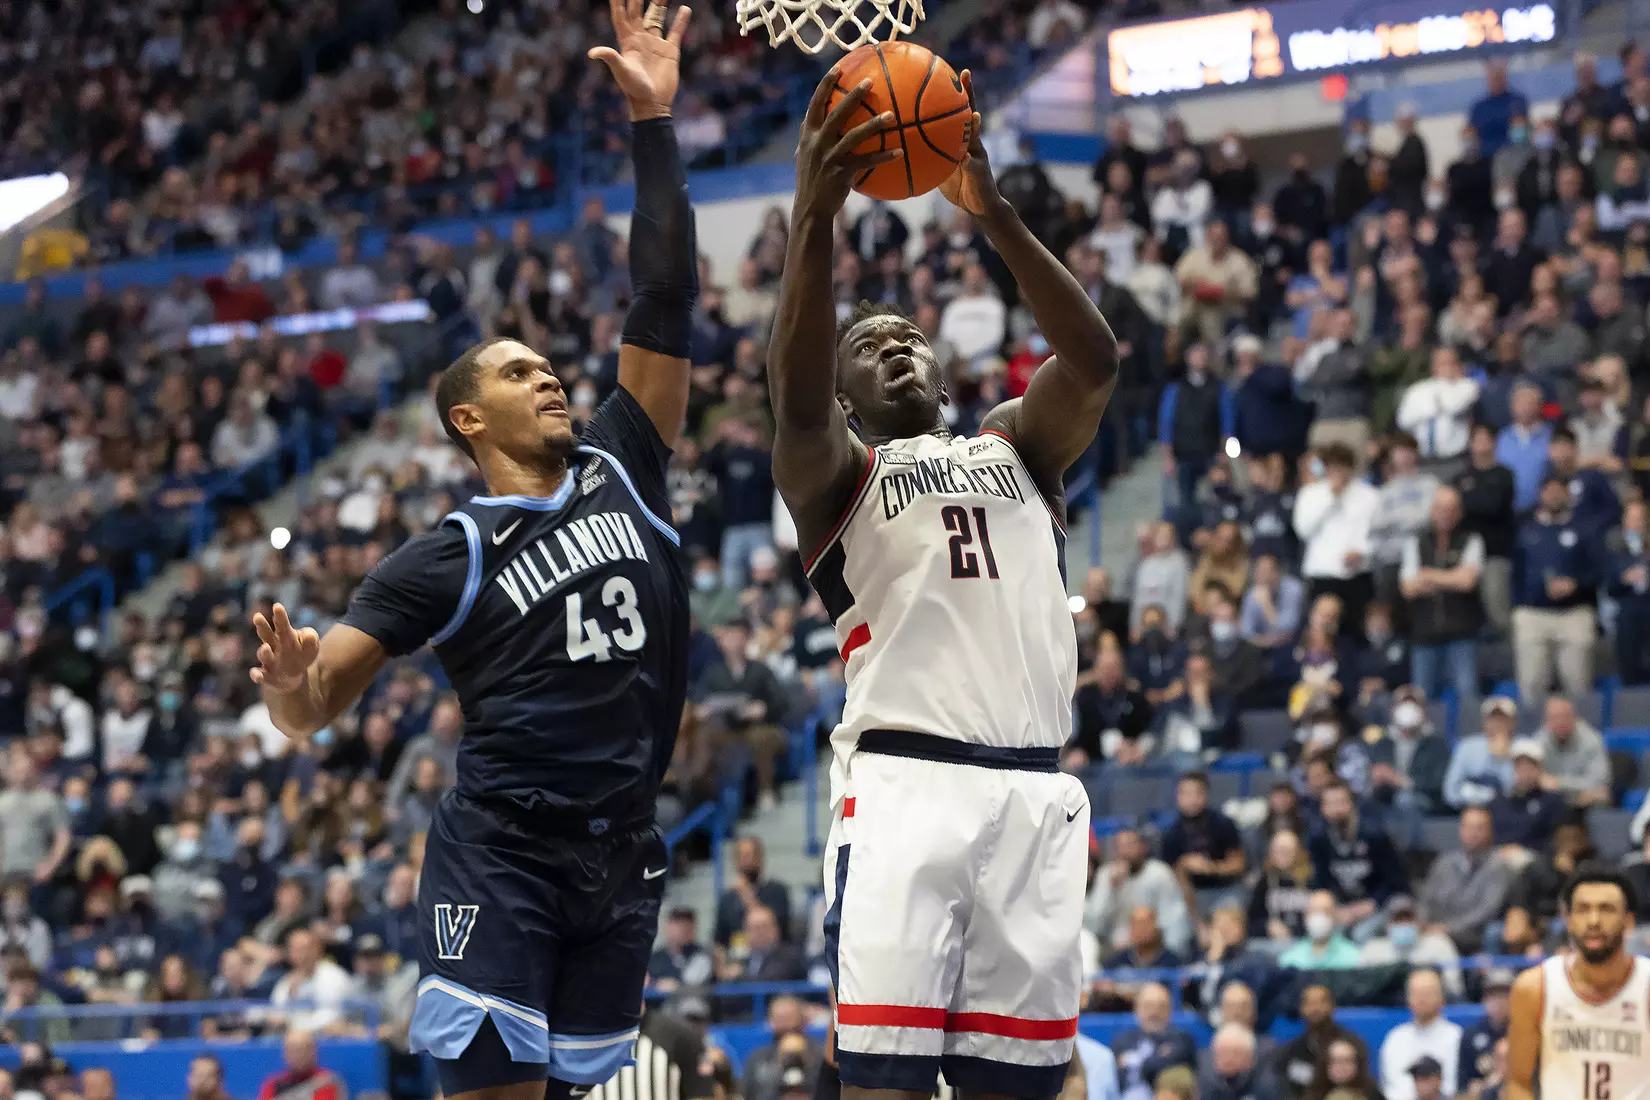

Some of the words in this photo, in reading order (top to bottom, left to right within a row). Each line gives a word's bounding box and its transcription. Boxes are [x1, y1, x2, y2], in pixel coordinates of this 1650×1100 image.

[881, 457, 1025, 520] CONNECTICUT
[496, 512, 650, 616] VILLANOVA
[941, 505, 1000, 579] 21
[566, 576, 647, 663] 43
[435, 903, 479, 960] V
[1583, 1060, 1612, 1100] 12
